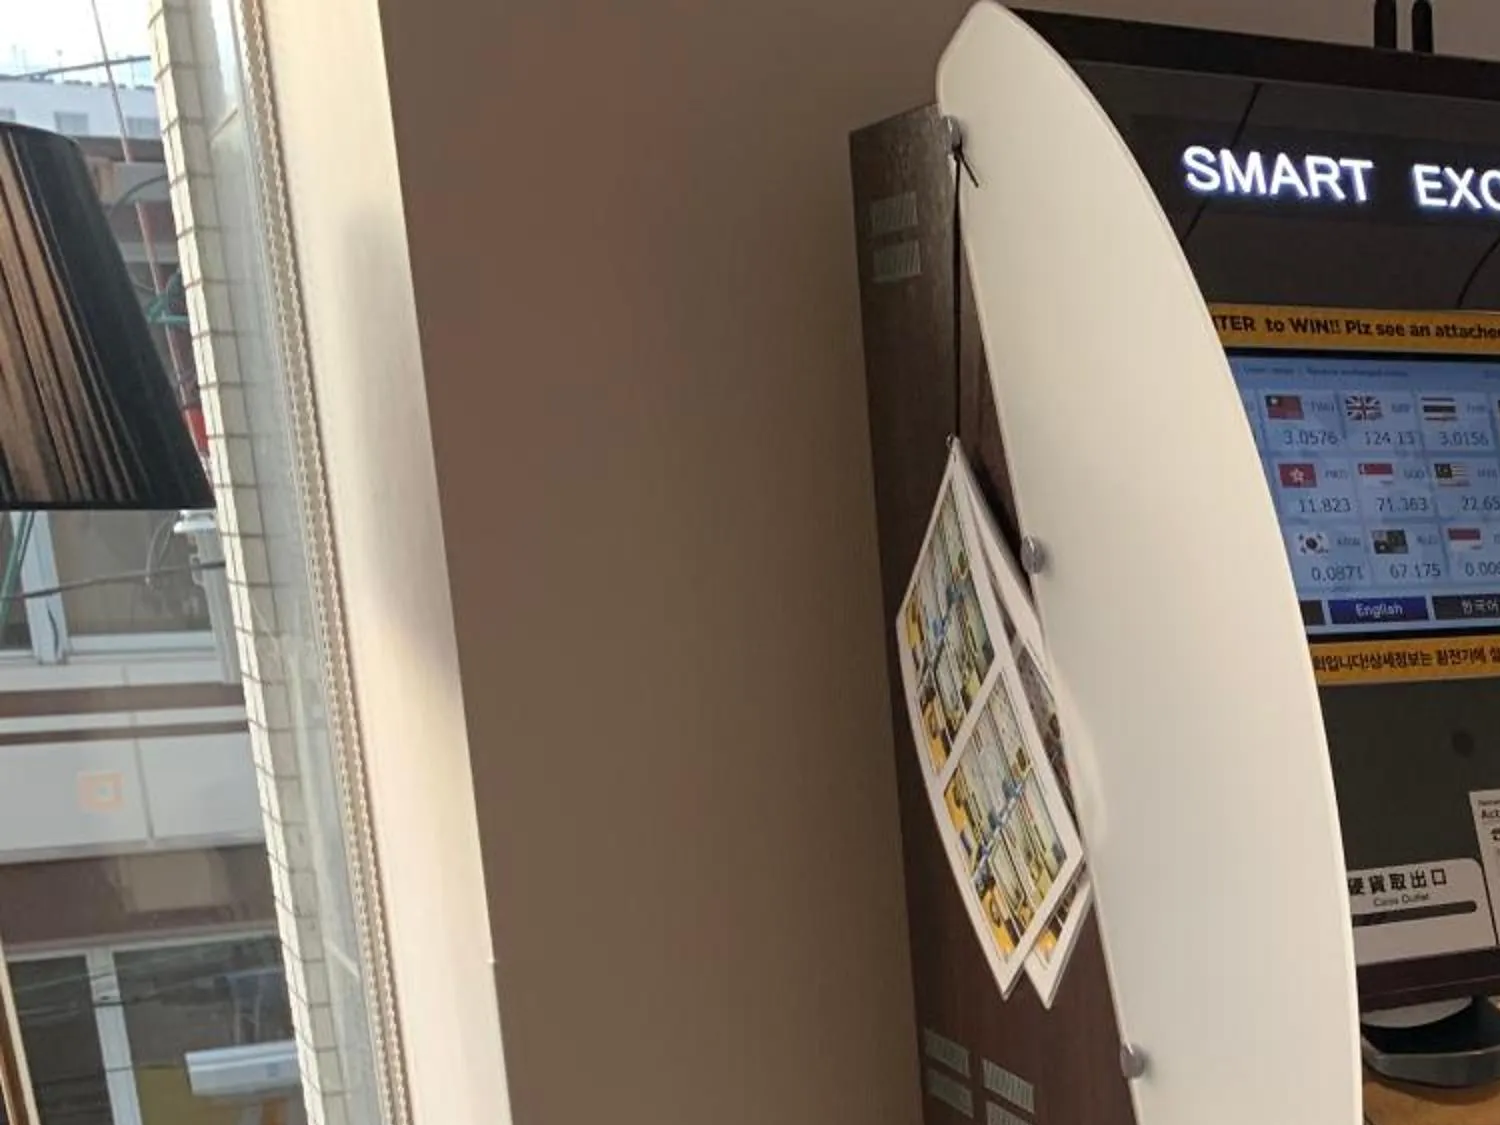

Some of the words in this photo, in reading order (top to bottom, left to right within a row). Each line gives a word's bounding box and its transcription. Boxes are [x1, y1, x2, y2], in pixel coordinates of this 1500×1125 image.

[1182, 145, 1374, 203] SMART
[1265, 317, 1286, 332] to
[1344, 321, 1373, 336] Plz
[1375, 323, 1405, 337] see
[1409, 325, 1431, 338] an
[1355, 601, 1404, 618] English
[1461, 598, 1500, 615] 한국어
